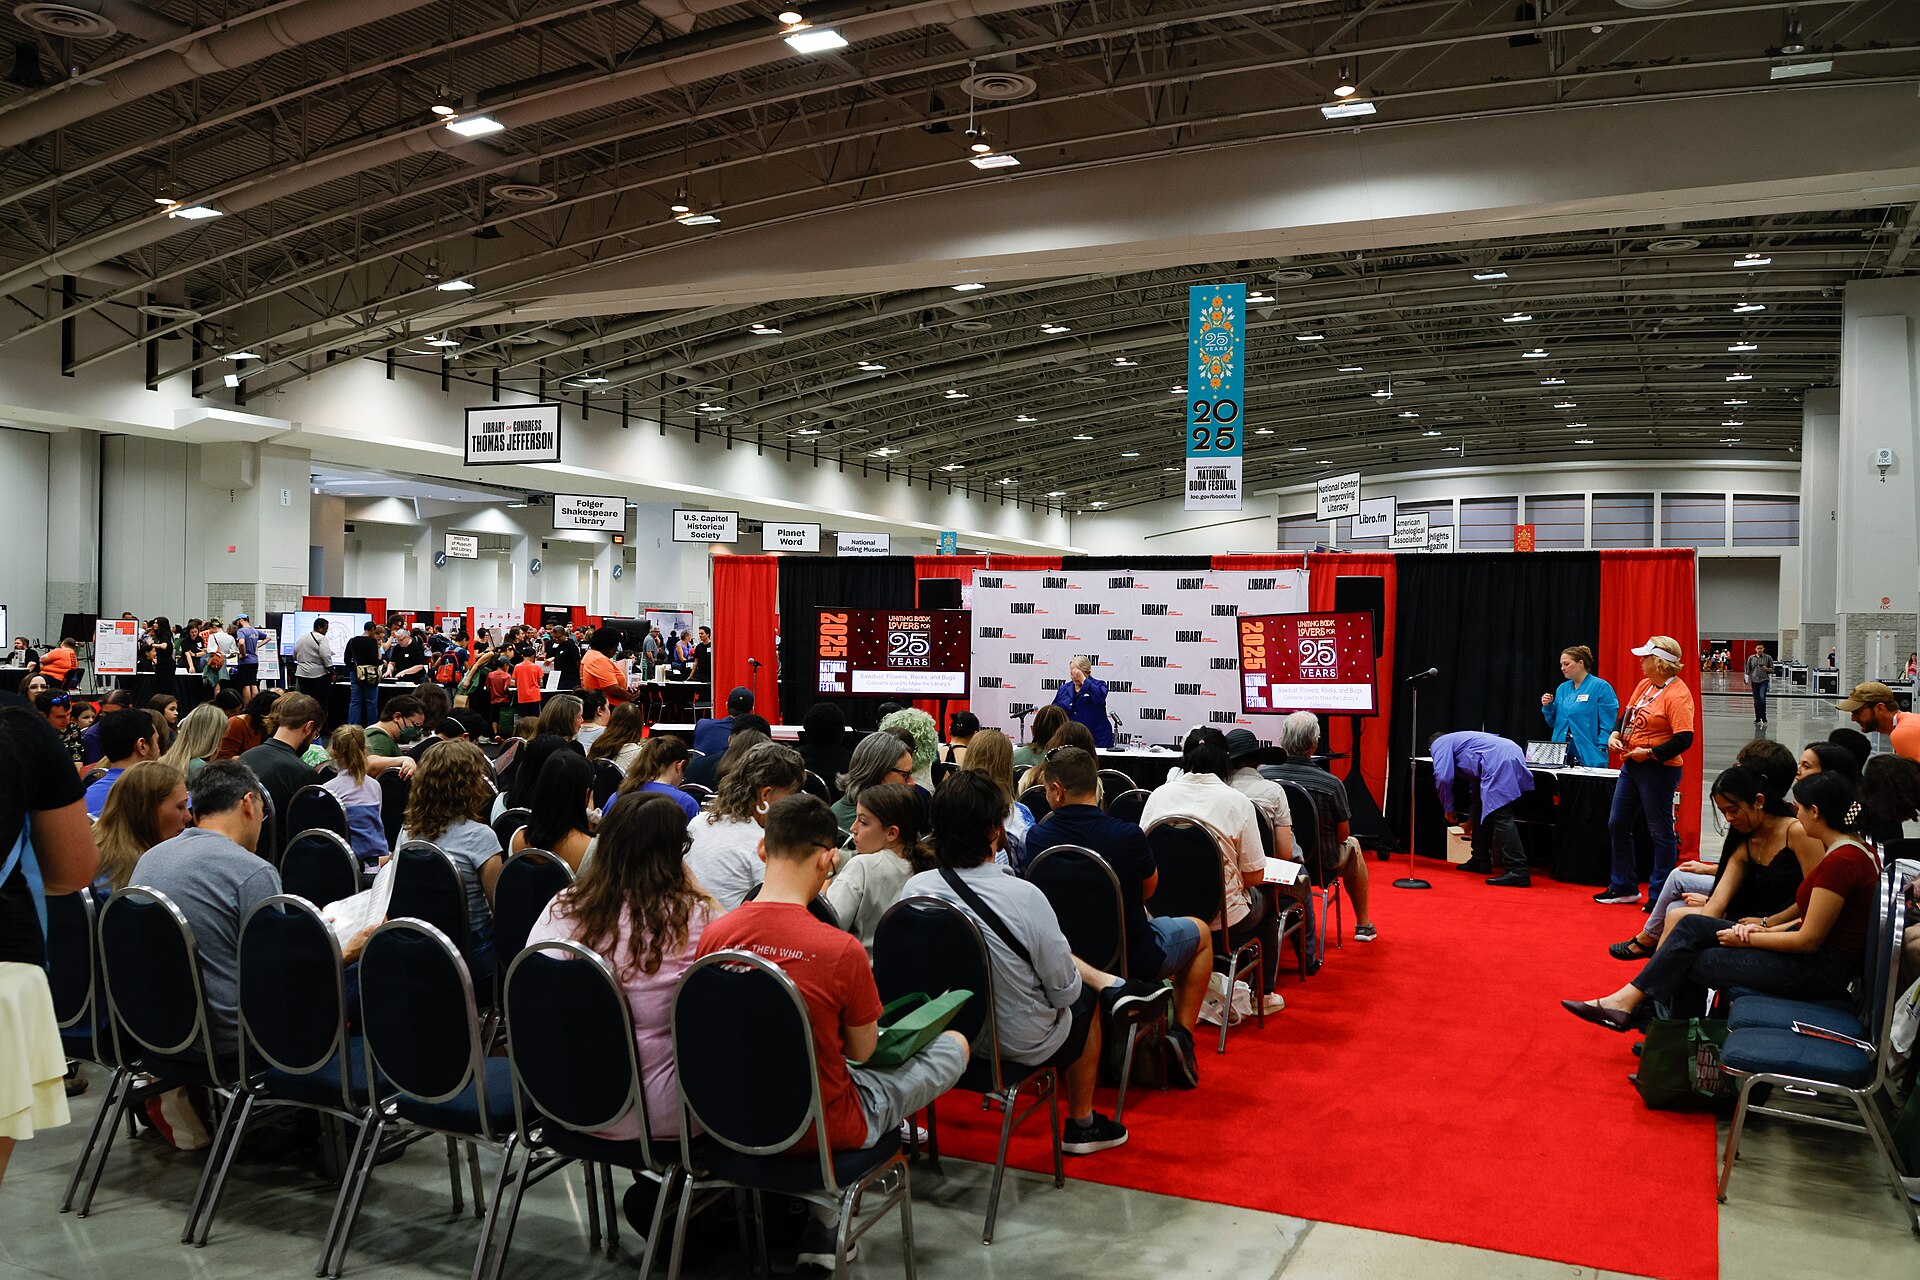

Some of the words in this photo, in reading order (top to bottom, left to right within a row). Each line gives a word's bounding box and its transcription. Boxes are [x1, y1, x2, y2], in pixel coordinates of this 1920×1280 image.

[1205, 332, 1228, 346] 25
[1193, 399, 1239, 424] 20
[483, 421, 505, 434] LIBRARY
[513, 420, 542, 432] CONGRESS
[472, 434, 505, 452] THOMAS
[507, 432, 554, 451] JEFFERSON
[1192, 426, 1236, 451] 25
[1198, 469, 1227, 480] NATIONAL
[1189, 480, 1206, 491] BOOK
[1208, 480, 1237, 490] FESTIVAL
[1319, 482, 1339, 494] National
[1340, 480, 1358, 489] Center
[1329, 490, 1355, 503] Improving
[576, 500, 604, 509] Folger
[1328, 503, 1349, 512] Literacy
[561, 507, 619, 517] Shakespeare
[574, 517, 606, 527] Library
[1360, 513, 1387, 524] Libro.fm
[691, 532, 721, 540] Society
[777, 529, 806, 537] Planet
[780, 538, 803, 546] Word
[1394, 536, 1423, 544] Association
[979, 577, 1003, 589] LIBRARY
[1042, 577, 1068, 589] LIBRARY
[1109, 577, 1135, 589] LIBRARY
[1177, 578, 1204, 590] LIBRARY
[1248, 578, 1277, 590] LIBRARY
[1011, 603, 1035, 614] LIBRARY
[1075, 604, 1100, 615] LIBRARY
[1142, 604, 1168, 615] LIBRARY
[1211, 605, 1239, 616] LIBRARY
[820, 613, 848, 657] 2025
[979, 627, 1003, 638] LIBRARY
[1042, 628, 1067, 640] LIBRARY
[1108, 629, 1133, 641] LIBRARY
[1175, 631, 1202, 642] LIBRARY
[1298, 628, 1325, 636] LOVERS
[889, 632, 929, 655] 25
[1242, 622, 1266, 670] 2025
[1010, 653, 1034, 664] LIBRARY
[1299, 640, 1336, 666] 25
[1141, 656, 1168, 668] LIBRARY
[1210, 658, 1238, 670] LIBRARY
[1301, 669, 1336, 677] YEARS
[979, 677, 1002, 688] LIBRARY
[1175, 683, 1201, 695] LIBRARY
[1140, 708, 1166, 720] LIBRARY
[1209, 711, 1236, 723] LIBRARY
[752, 944, 777, 955] THEN
